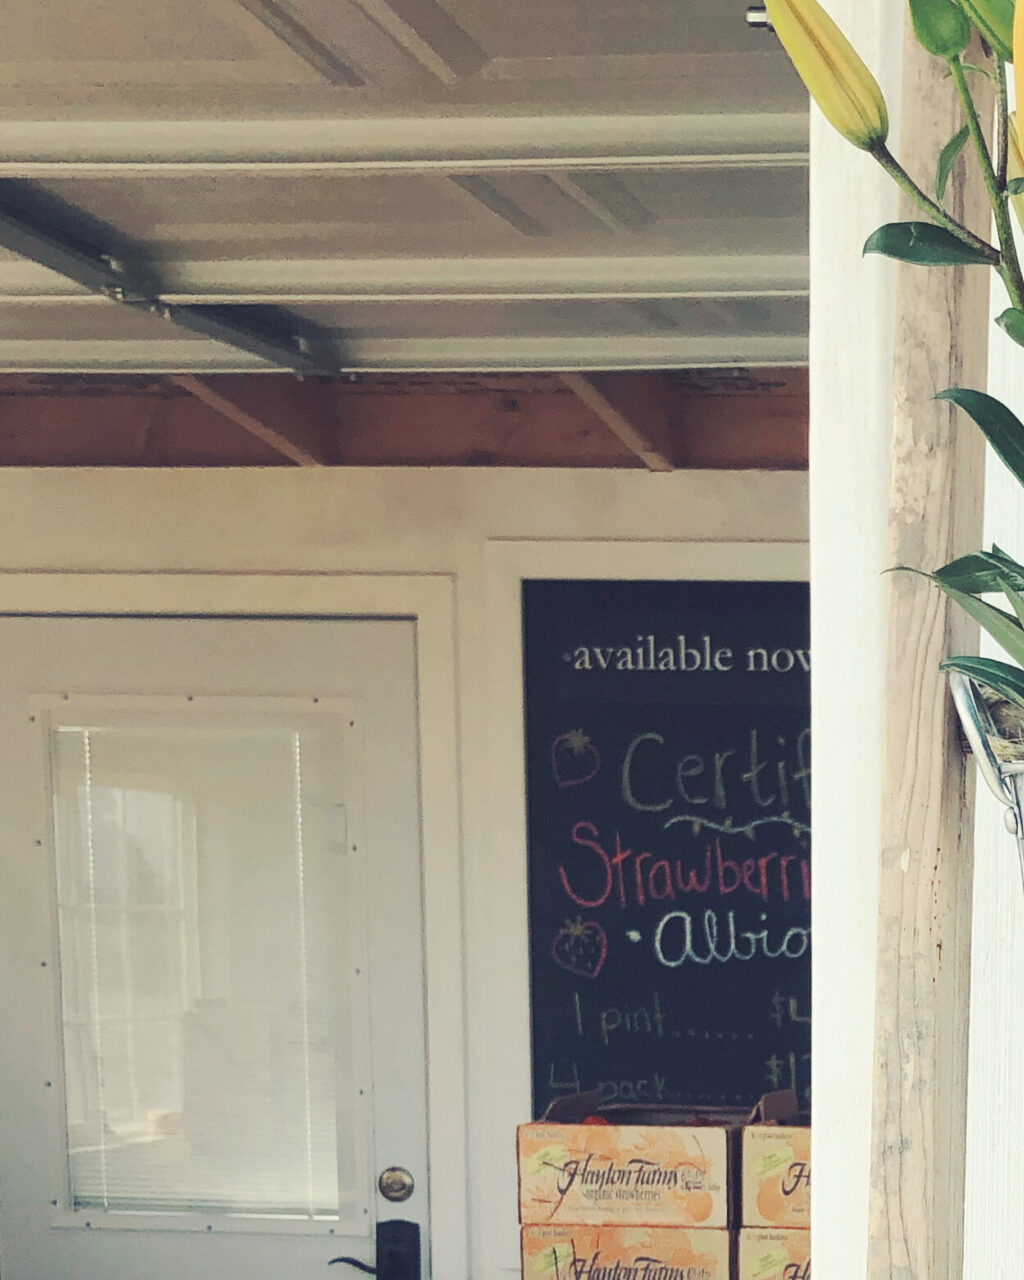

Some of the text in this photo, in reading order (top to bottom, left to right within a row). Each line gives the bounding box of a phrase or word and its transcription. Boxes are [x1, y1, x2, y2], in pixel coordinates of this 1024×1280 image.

[574, 635, 733, 671] available
[557, 1153, 630, 1195] Hayton
[628, 1159, 678, 1190] Farms
